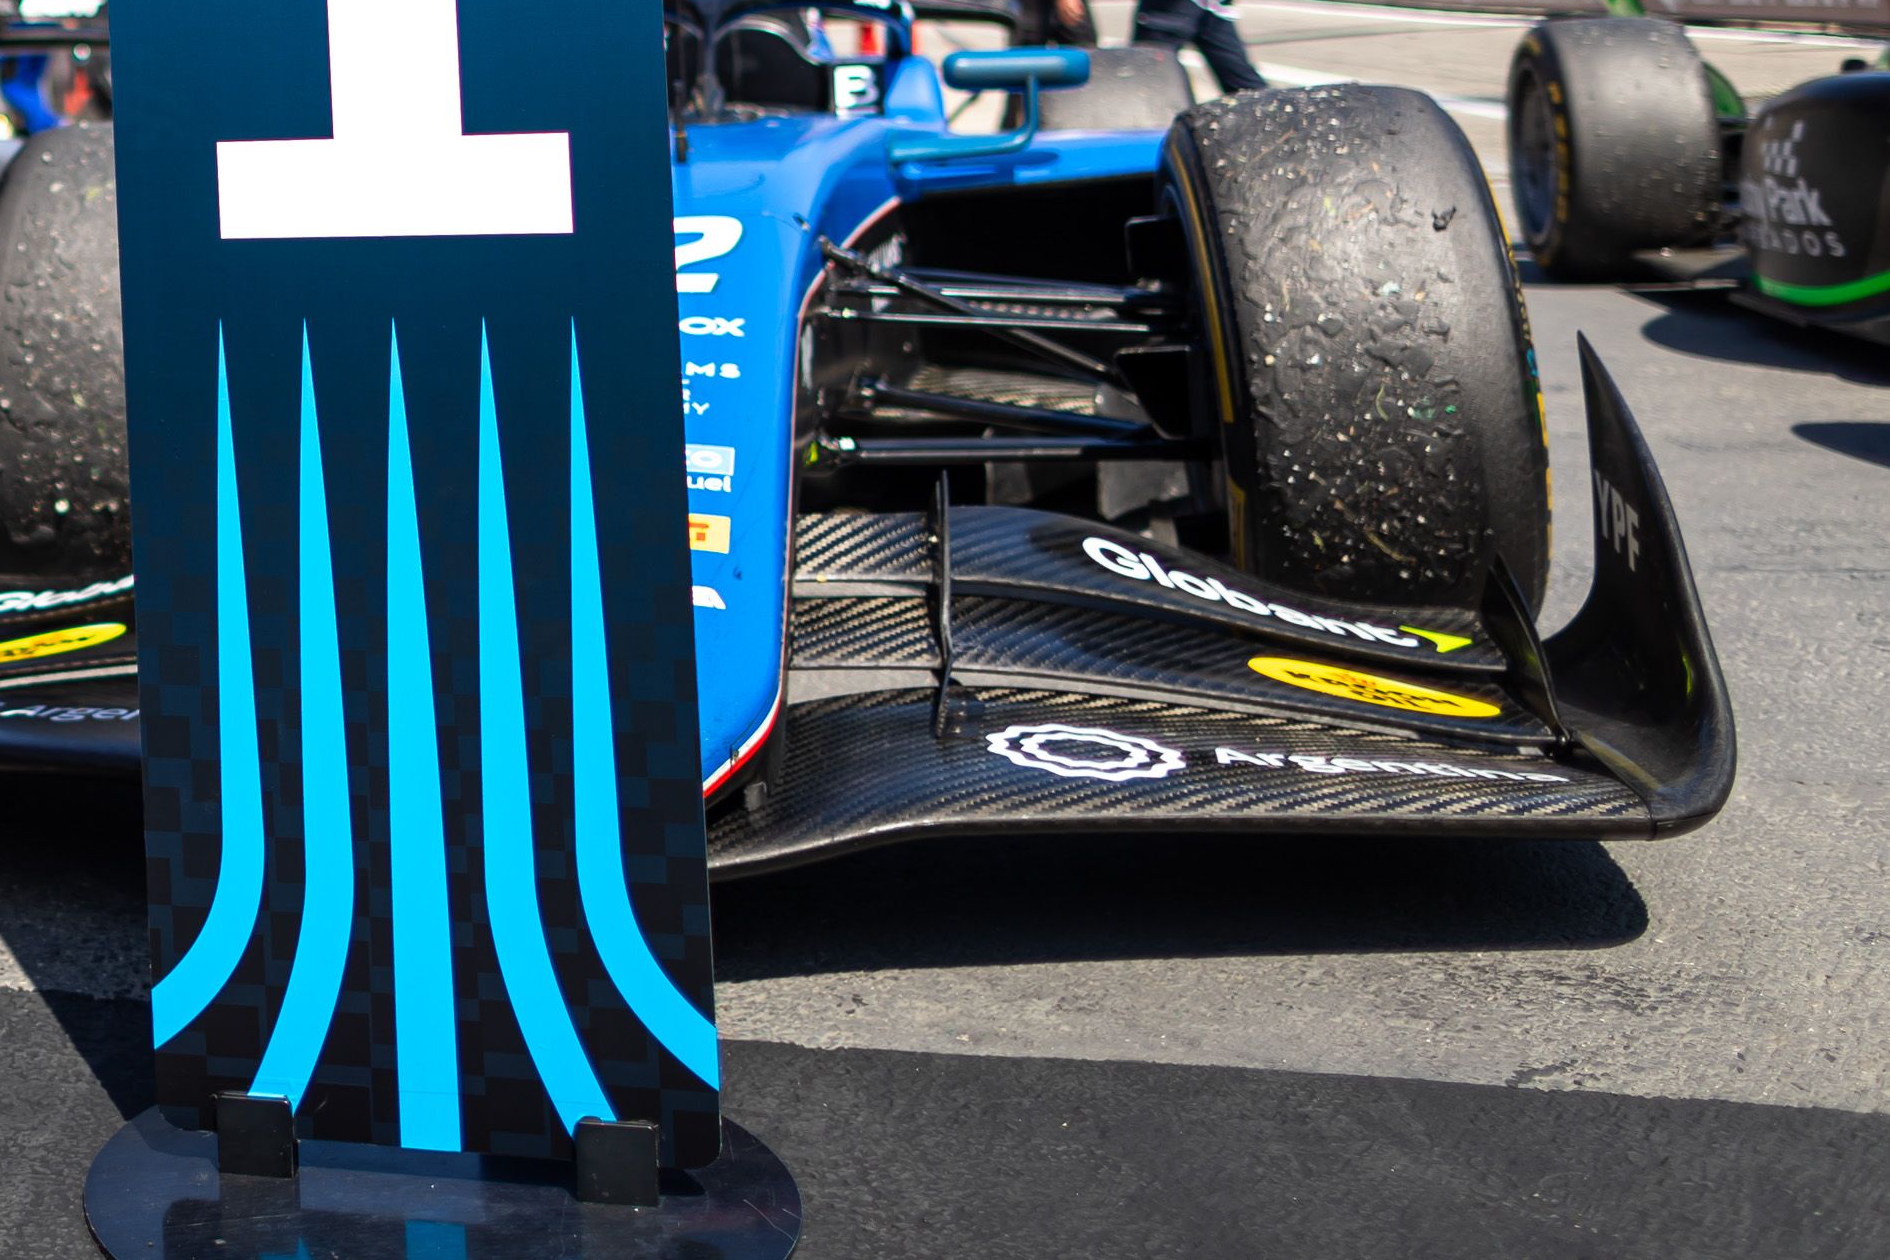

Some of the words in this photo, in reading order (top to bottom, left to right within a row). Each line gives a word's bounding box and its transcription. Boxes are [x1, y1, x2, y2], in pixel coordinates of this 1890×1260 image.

[1594, 468, 1640, 572] YPF
[1081, 536, 1420, 648] Globant
[1213, 746, 1570, 783] Argentina
